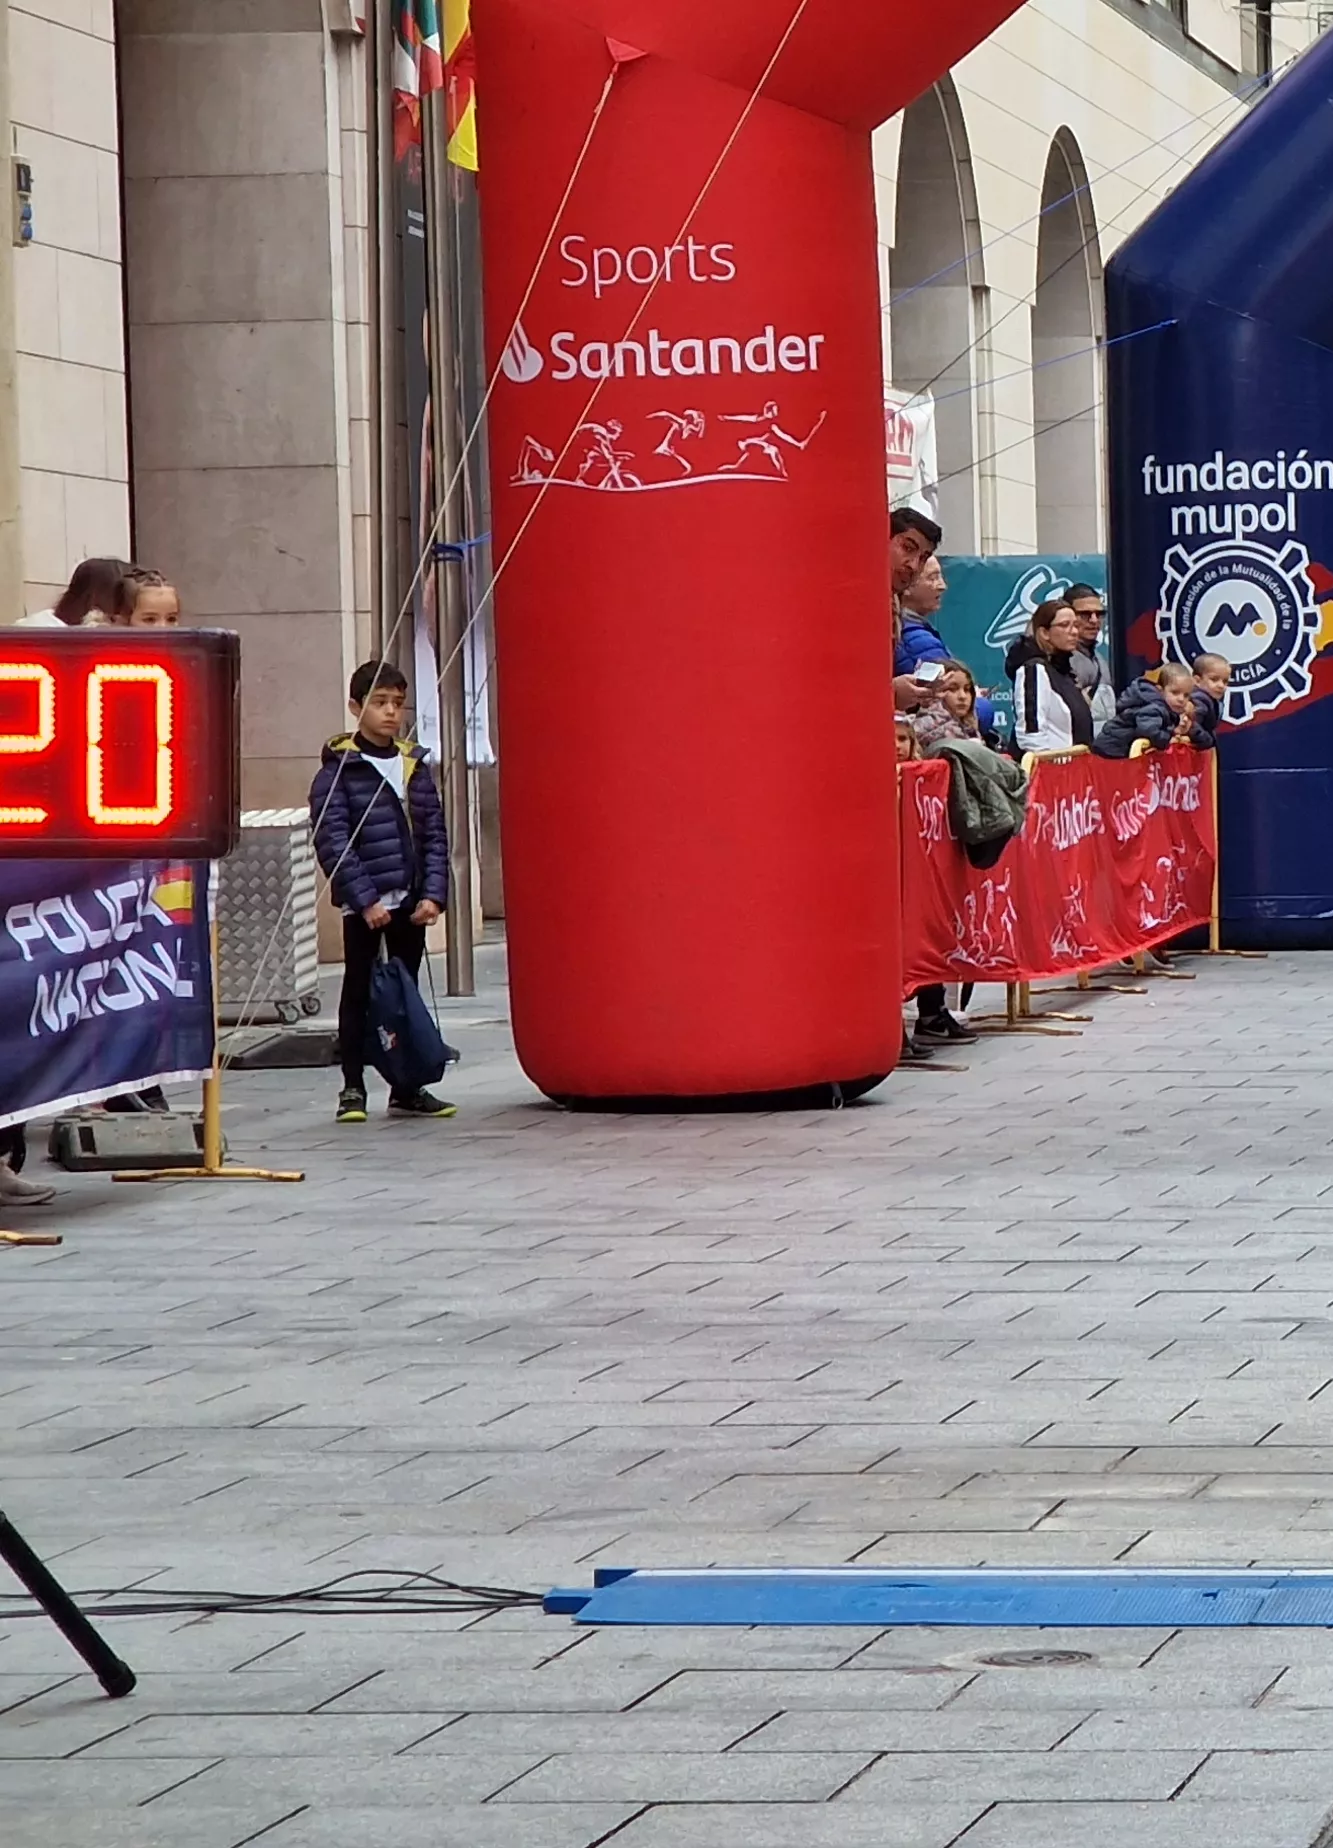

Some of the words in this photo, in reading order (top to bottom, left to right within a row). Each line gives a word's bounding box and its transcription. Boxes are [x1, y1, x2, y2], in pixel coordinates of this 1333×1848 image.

[560, 235, 736, 298] Sports
[550, 325, 825, 380] Santander
[1171, 492, 1296, 540] mupol
[1181, 581, 1204, 634] Fundación
[1204, 570, 1217, 582] de
[1218, 565, 1229, 575] la
[1232, 563, 1287, 601] Mutualidad
[1228, 663, 1267, 682] LICÍA
[0, 663, 174, 826] 20
